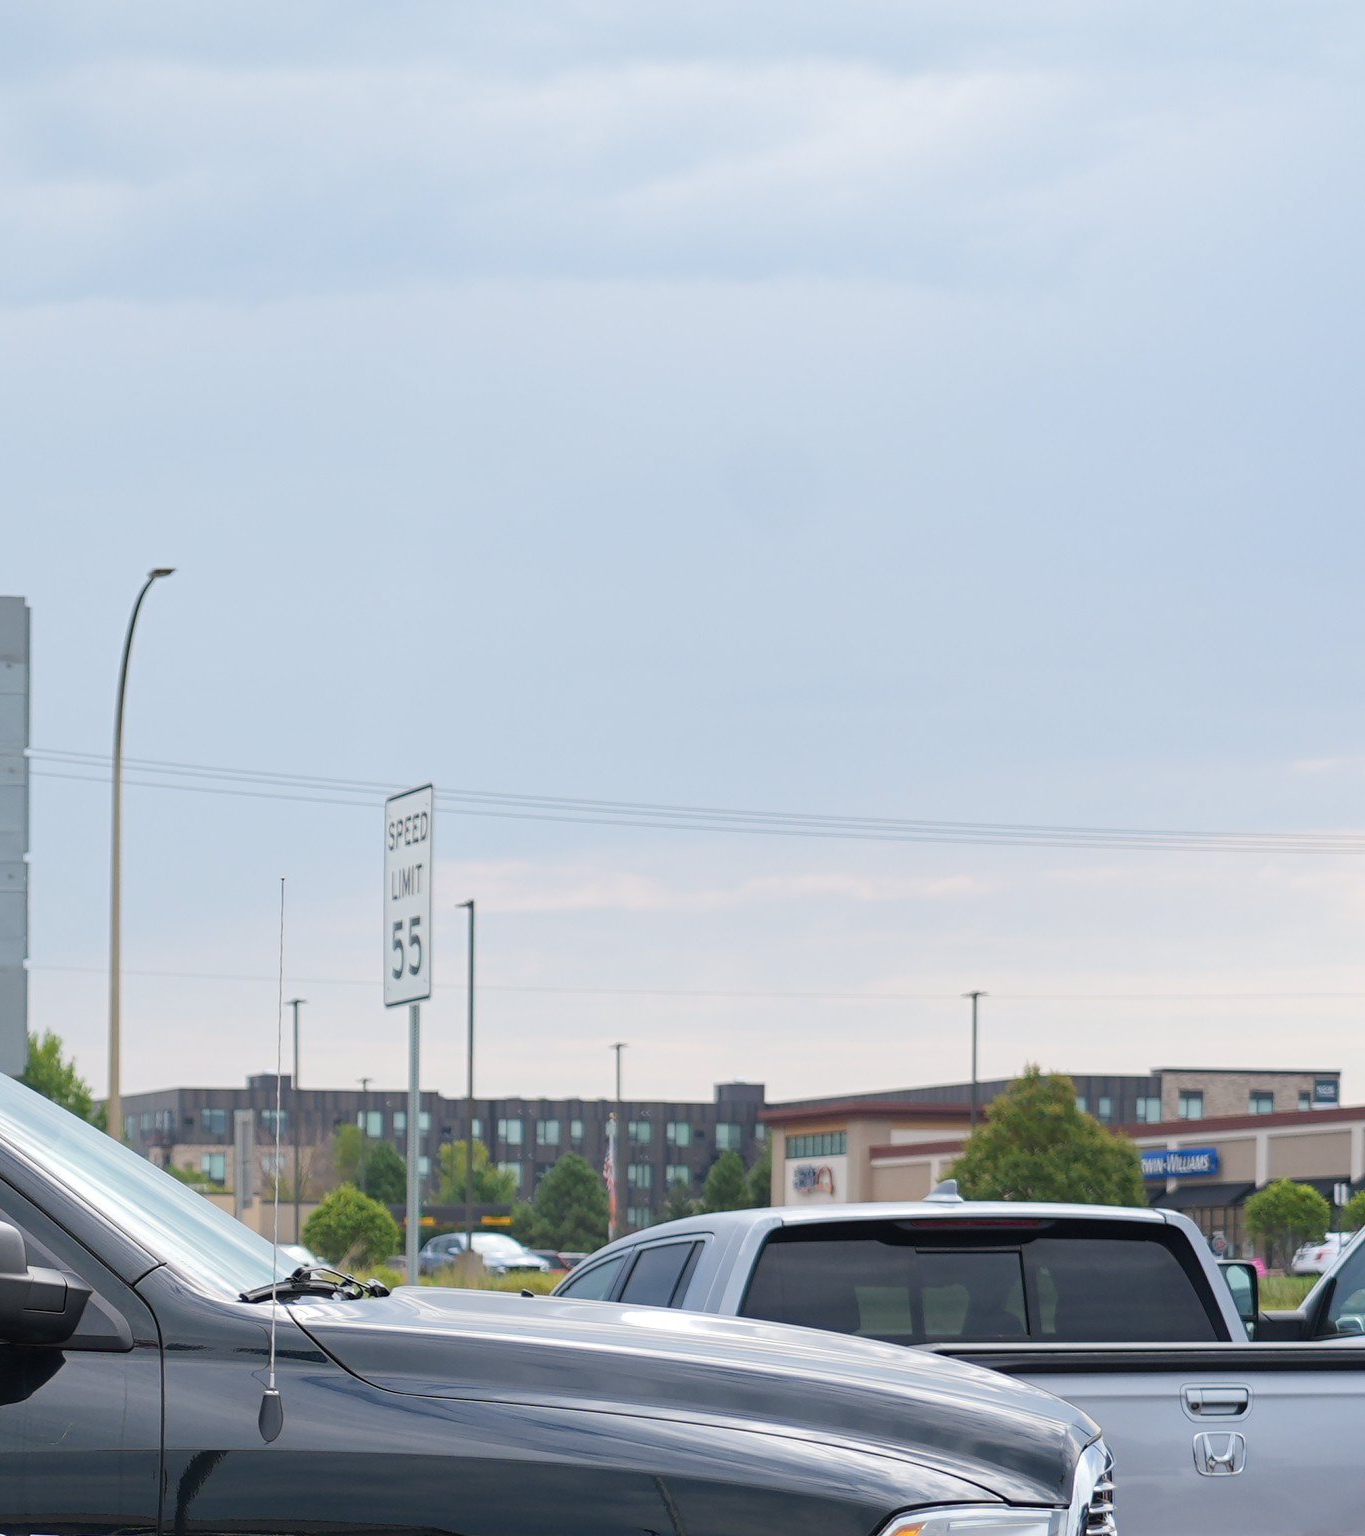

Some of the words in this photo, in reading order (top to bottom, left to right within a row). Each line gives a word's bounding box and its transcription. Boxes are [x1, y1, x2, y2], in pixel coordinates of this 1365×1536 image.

[388, 811, 428, 851] SPEED
[391, 863, 423, 901] LIMIT
[391, 915, 423, 980] 55
